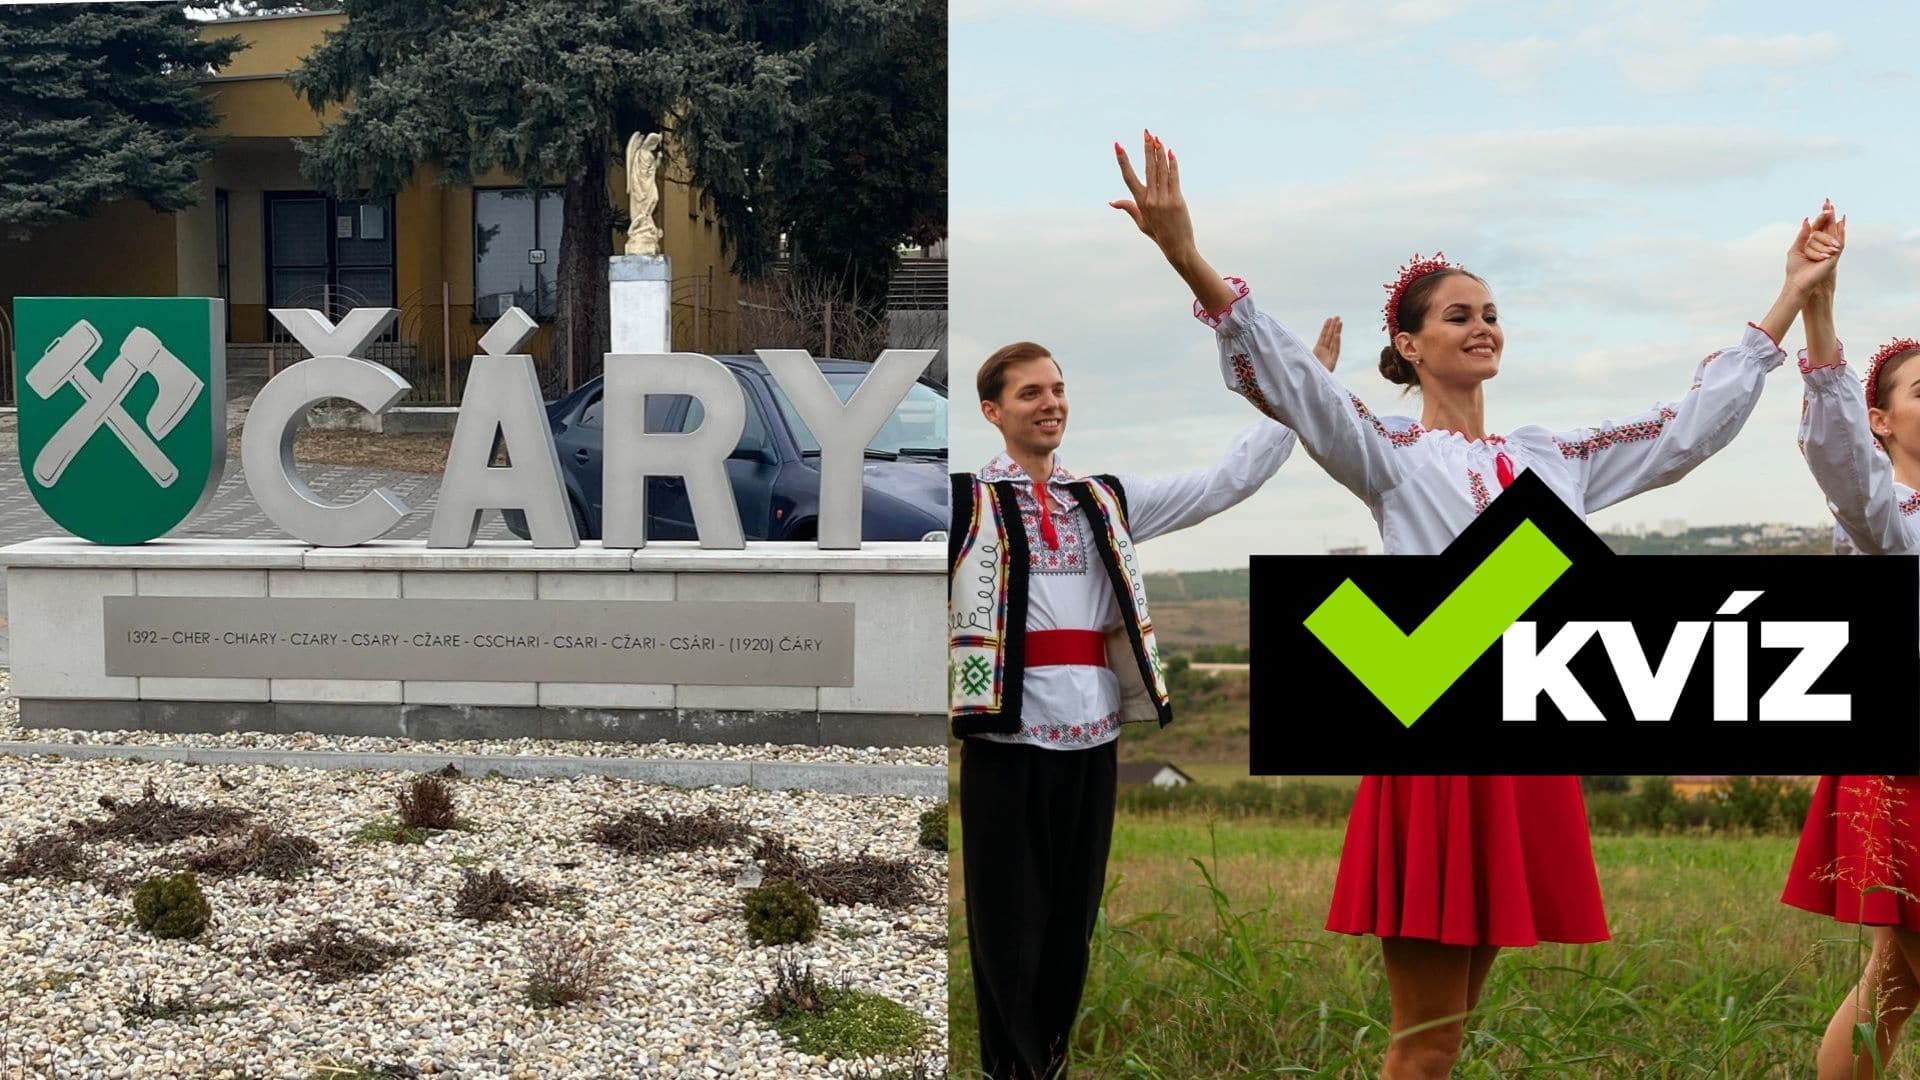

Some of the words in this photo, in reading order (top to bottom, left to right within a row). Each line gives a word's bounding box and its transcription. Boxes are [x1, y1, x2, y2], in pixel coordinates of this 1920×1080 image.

[241, 305, 940, 550] ČÁRY
[127, 630, 158, 645] 1392
[172, 631, 211, 646] CHER
[223, 632, 278, 646] CHIARY
[290, 632, 338, 647] CZARY
[350, 633, 400, 648] CSARY
[412, 631, 461, 649] CŽARE
[473, 634, 540, 649] CSCHARI
[553, 635, 599, 650] CSARI
[610, 633, 656, 651] CŽARI
[669, 634, 715, 651] CSÁRI
[728, 636, 774, 654] (1920)
[778, 634, 823, 653] ČÁRY
